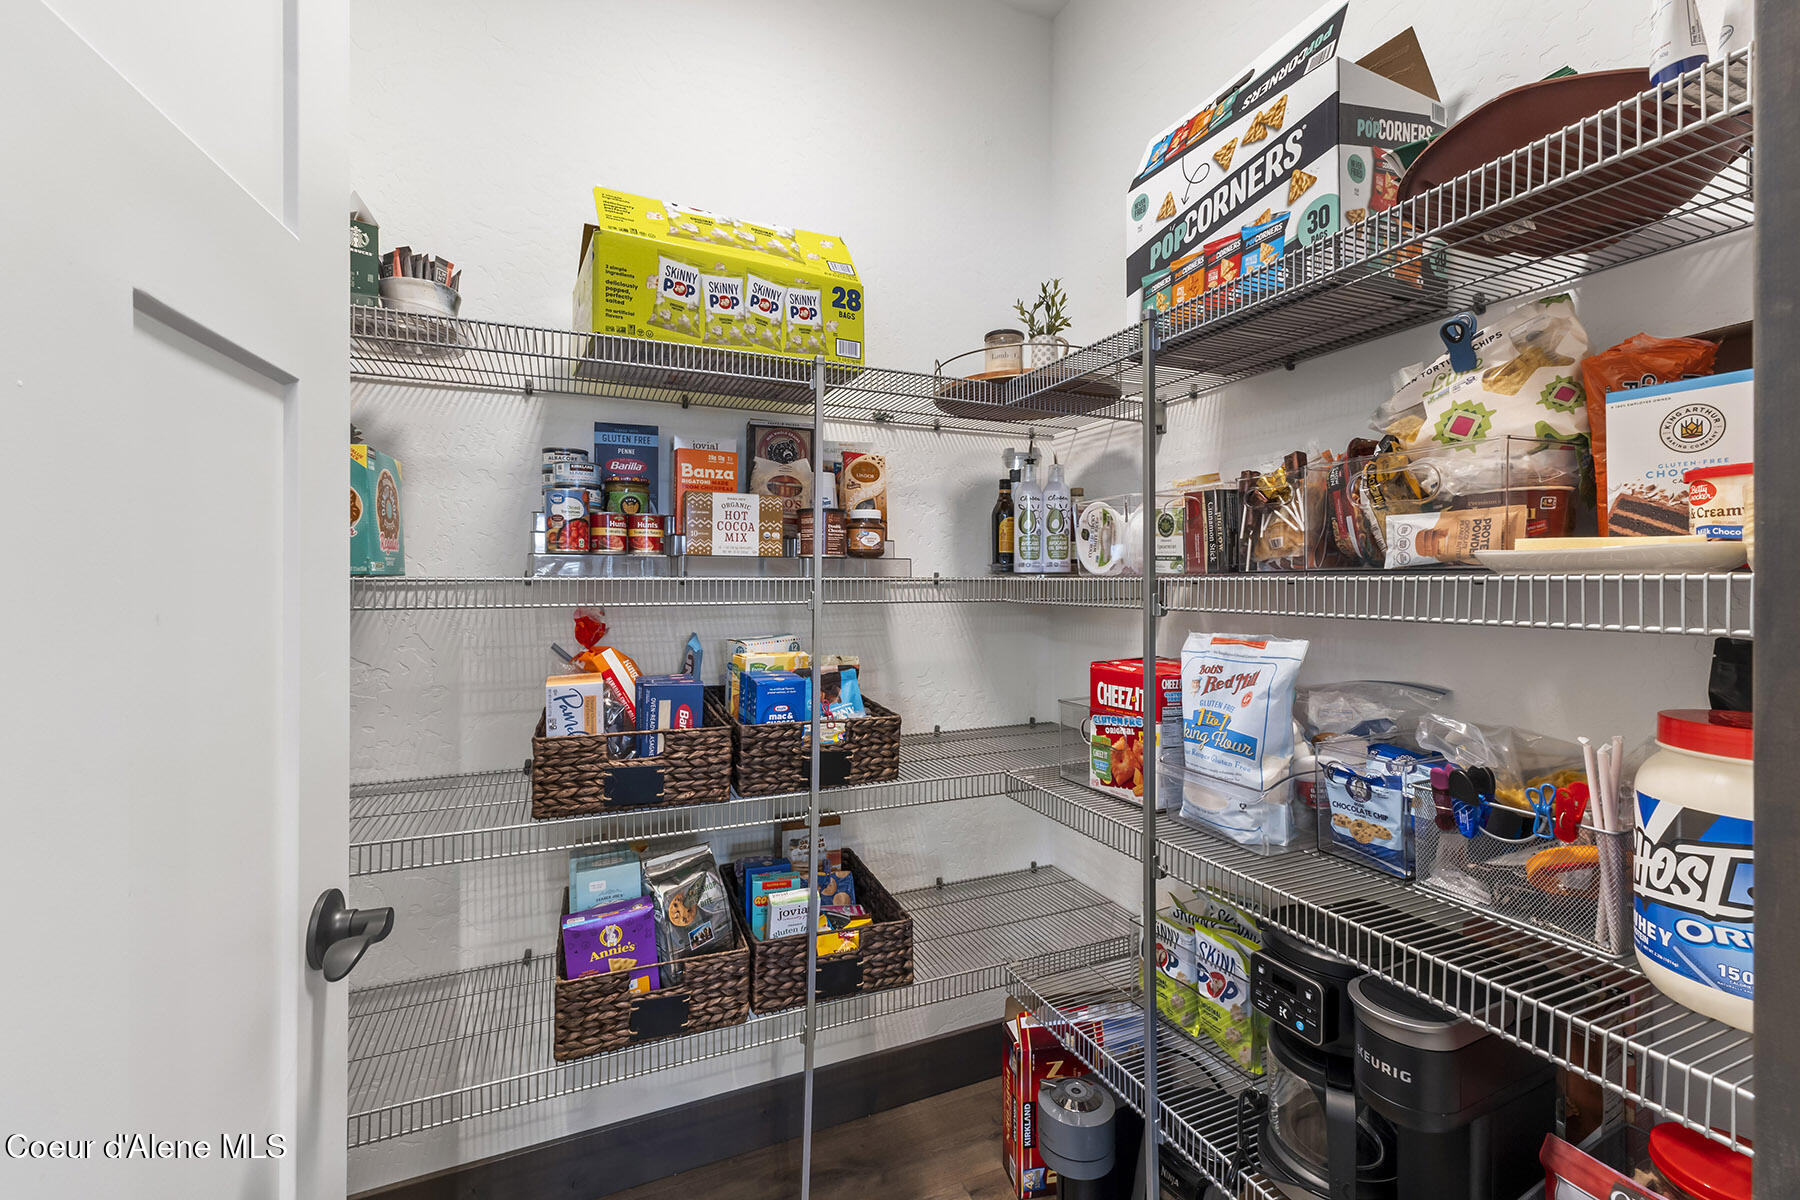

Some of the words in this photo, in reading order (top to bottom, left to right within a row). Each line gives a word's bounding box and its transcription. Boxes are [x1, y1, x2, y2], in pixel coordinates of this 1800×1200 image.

[1241, 24, 1334, 111] POPCORNERS
[1356, 117, 1433, 142] POPCORNERS
[1350, 158, 1362, 168] NEVER
[1134, 198, 1146, 210] NEVER
[1150, 127, 1304, 270] POPCORNERS
[1307, 204, 1330, 234] 30
[605, 280, 638, 290] deliciously
[663, 278, 696, 298] POP
[605, 292, 632, 302] perfectly
[709, 294, 740, 310] POP
[750, 294, 779, 314] POP
[832, 286, 862, 312] 28
[790, 306, 818, 320] POP
[838, 311, 856, 320] BAGS
[1472, 332, 1502, 351] CHIPS
[1421, 360, 1450, 378] TORTI
[1664, 411, 1682, 430] KING
[1685, 406, 1721, 424] ARTHUR
[602, 434, 631, 444] GLUTEN
[634, 436, 650, 444] FREE
[692, 440, 718, 450] jovial
[1666, 436, 1687, 449] BAKING
[1690, 431, 1718, 449] COMPANY
[610, 462, 642, 471] Barilla
[681, 462, 734, 480] Banza
[721, 502, 752, 510] ORGANIC
[724, 510, 748, 520] HOT
[1696, 507, 1744, 518] Cream
[716, 521, 755, 532] COCOA
[1215, 511, 1224, 552] BIGELOW
[1480, 518, 1492, 550] PROTE
[724, 533, 747, 542] MIX
[1199, 664, 1223, 675] Bob's
[1200, 675, 1236, 696] Red
[1232, 670, 1261, 696] Mill
[1200, 700, 1223, 708] GLUTEN
[1224, 704, 1236, 713] FREE
[1093, 715, 1124, 727] GLUTEN
[1124, 716, 1143, 728] FRE
[1198, 707, 1206, 726] 1
[1206, 711, 1220, 725] to
[1220, 713, 1229, 732] 1
[1212, 732, 1254, 756] Flour
[1332, 800, 1372, 817] CHOCOLATE
[1373, 812, 1389, 821] CHIP
[1634, 828, 1754, 906] HOST
[777, 905, 808, 921] jovia
[772, 926, 798, 938] gluten
[1156, 921, 1180, 949] iNNY
[1675, 919, 1754, 949] OR
[590, 941, 636, 963] Annie's
[1198, 962, 1238, 1003] POP
[1717, 964, 1754, 984] 150
[1357, 1043, 1412, 1084] KEURIG
